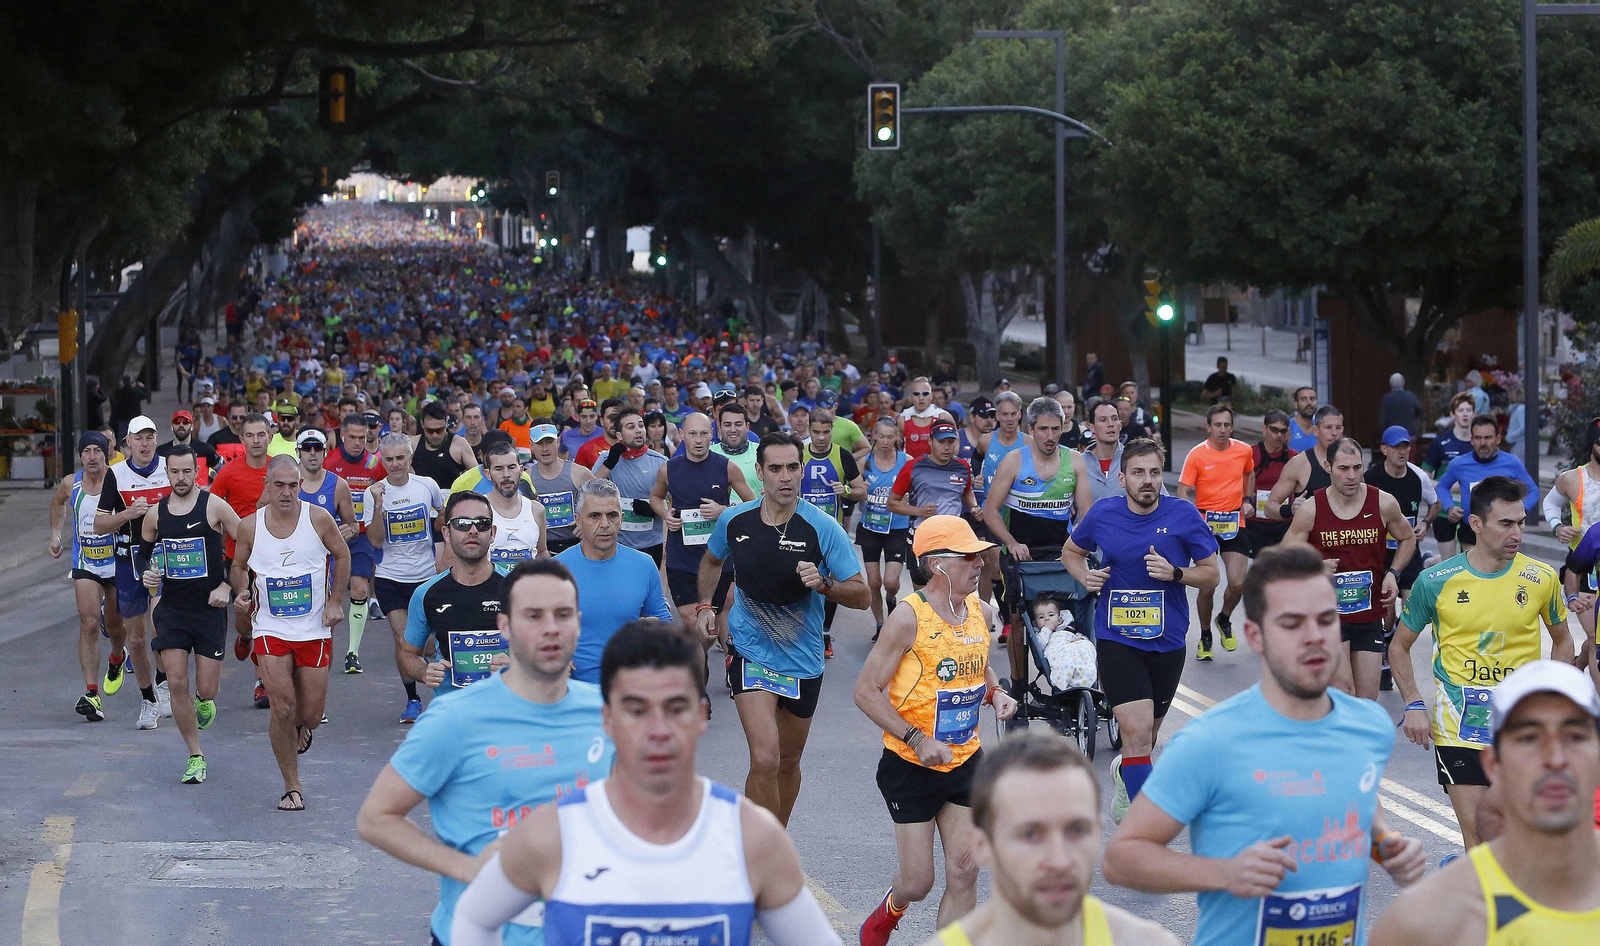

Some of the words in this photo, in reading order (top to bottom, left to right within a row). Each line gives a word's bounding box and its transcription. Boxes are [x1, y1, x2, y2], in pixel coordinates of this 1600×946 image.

[1017, 499, 1071, 509] TORREMOLINOS
[548, 506, 561, 514] 602
[400, 521, 417, 530] 1448
[694, 521, 711, 530] 5269
[1320, 530, 1338, 541] THE
[1340, 528, 1379, 540] SPANISH
[1321, 537, 1379, 547] CORREDORES
[176, 554, 190, 562] 861
[1436, 565, 1463, 577] Avanza
[1518, 571, 1542, 585] JADISA
[282, 592, 299, 600] 804
[1342, 589, 1358, 597] 553
[1125, 609, 1146, 619] 1021
[472, 653, 493, 664] 629
[955, 709, 972, 722] 495
[1308, 902, 1347, 916] ZURICH
[1296, 931, 1338, 946] 1146
